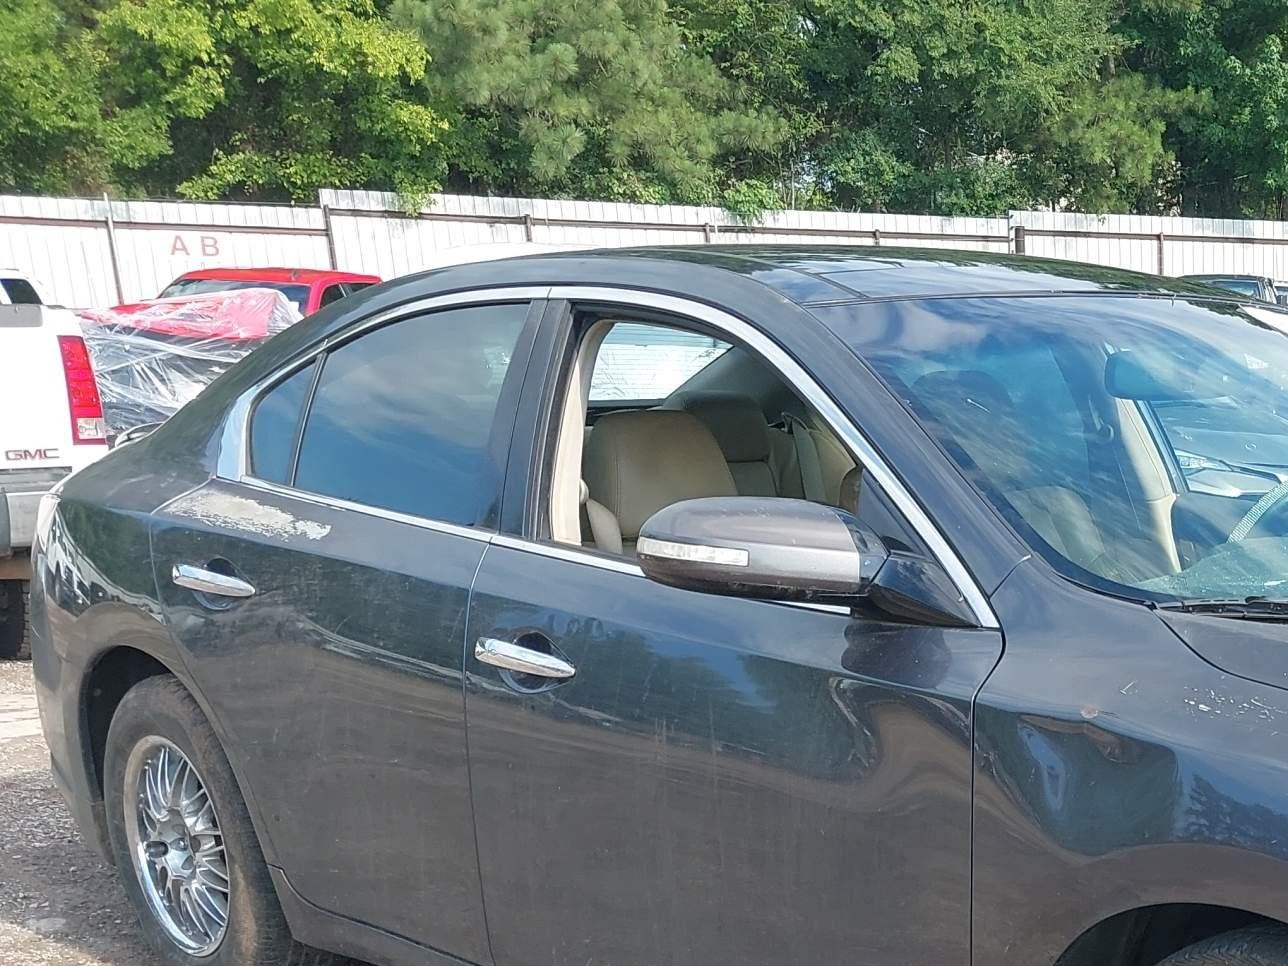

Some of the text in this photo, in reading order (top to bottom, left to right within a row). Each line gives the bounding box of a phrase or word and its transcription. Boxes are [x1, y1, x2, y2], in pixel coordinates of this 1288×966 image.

[171, 235, 219, 256] A B
[5, 448, 59, 460] GMC
